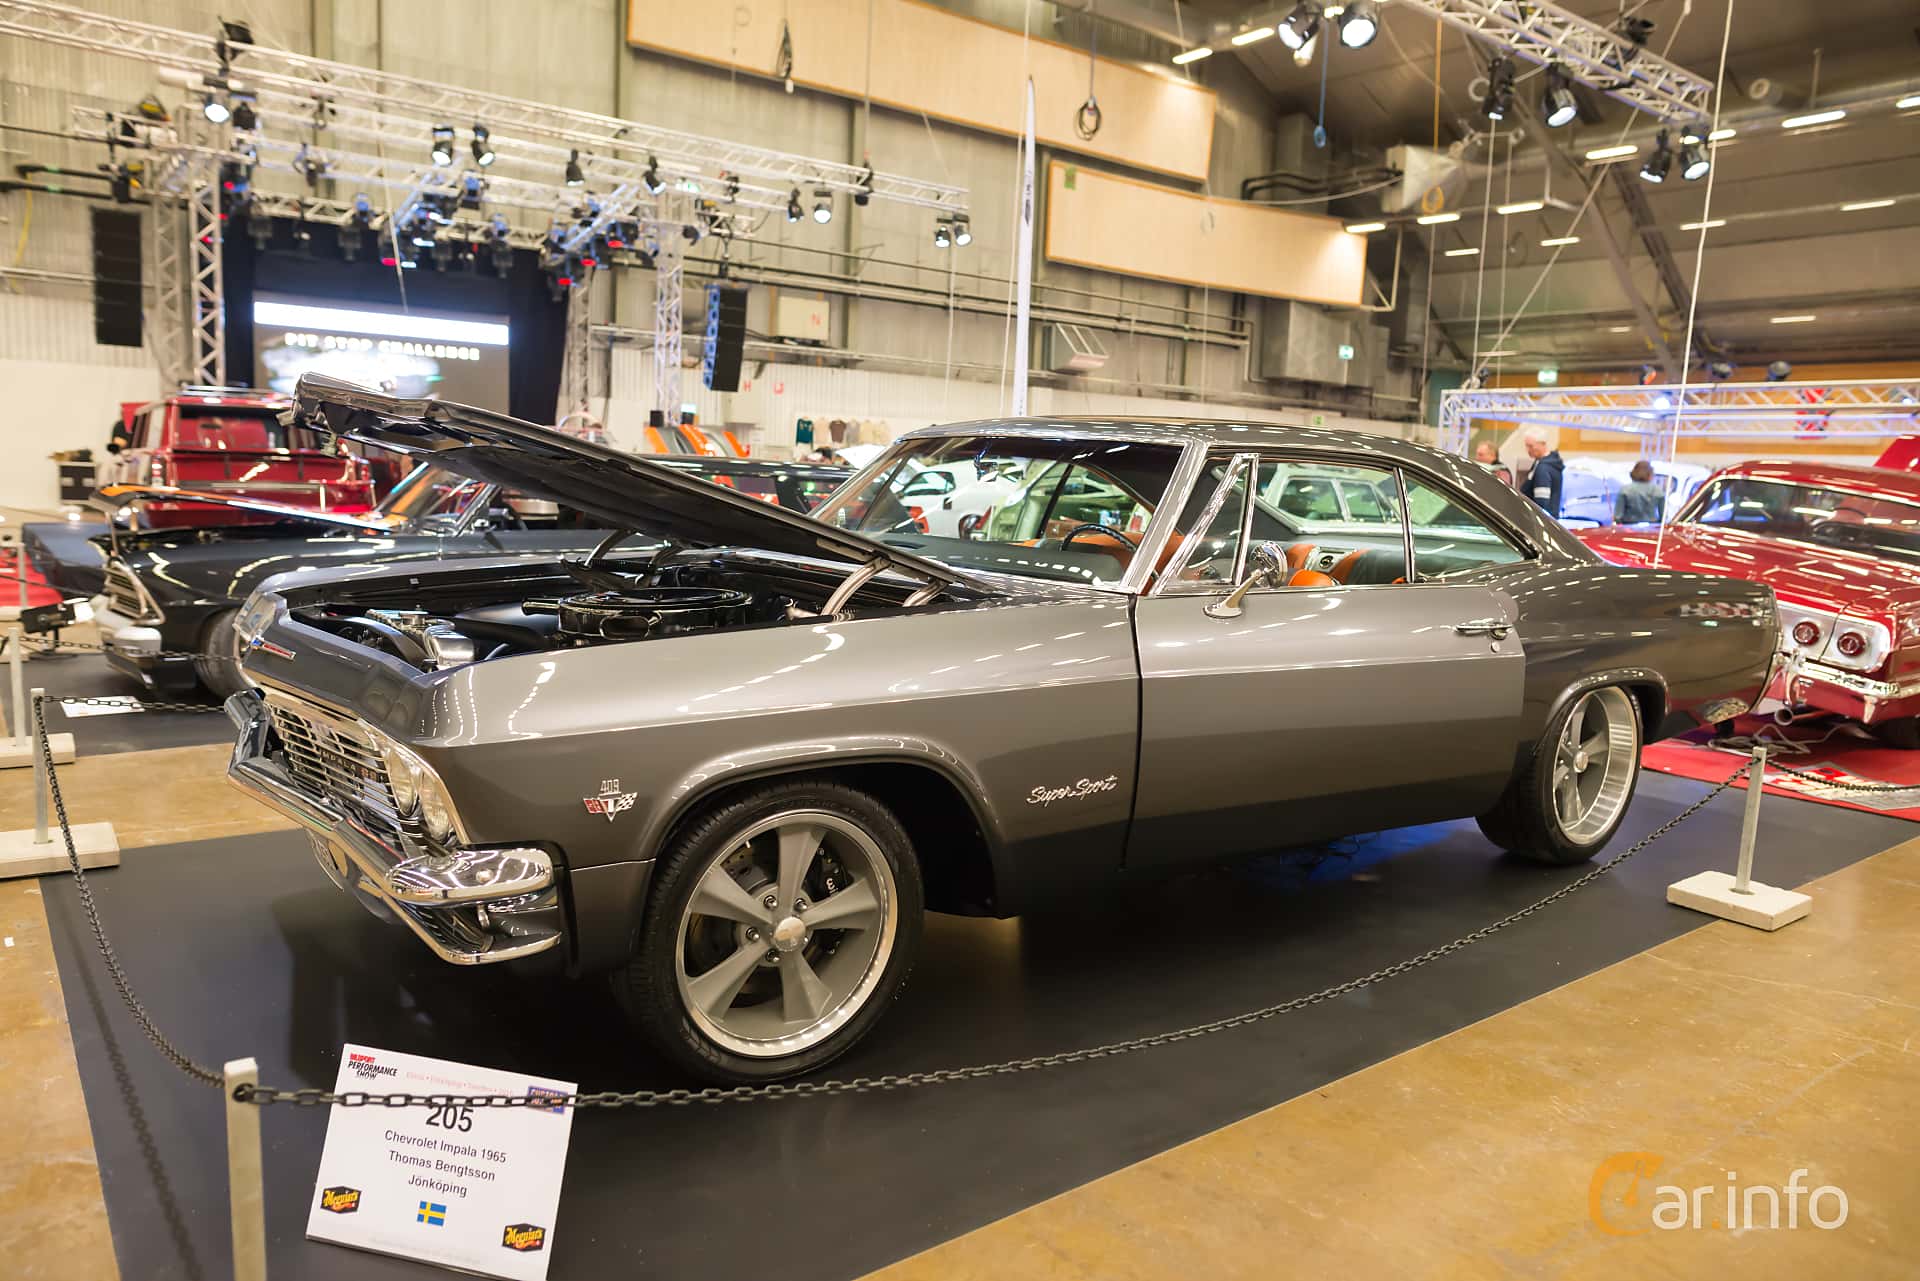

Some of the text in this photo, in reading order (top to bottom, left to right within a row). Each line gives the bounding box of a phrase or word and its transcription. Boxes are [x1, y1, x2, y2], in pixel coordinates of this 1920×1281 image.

[284, 332, 481, 361] PIT STOP CHALLENGE
[321, 750, 356, 771] MPALA
[600, 778, 620, 794] 409
[1026, 775, 1118, 808] Super Sport
[348, 1061, 398, 1077] PERFORMANCE
[356, 1070, 378, 1081] SHOW
[426, 1103, 474, 1132] 205
[384, 1129, 507, 1164] Chevrolet Impala 1965
[389, 1150, 496, 1182] Thomas Bengtsson
[408, 1174, 468, 1198] Jönköping
